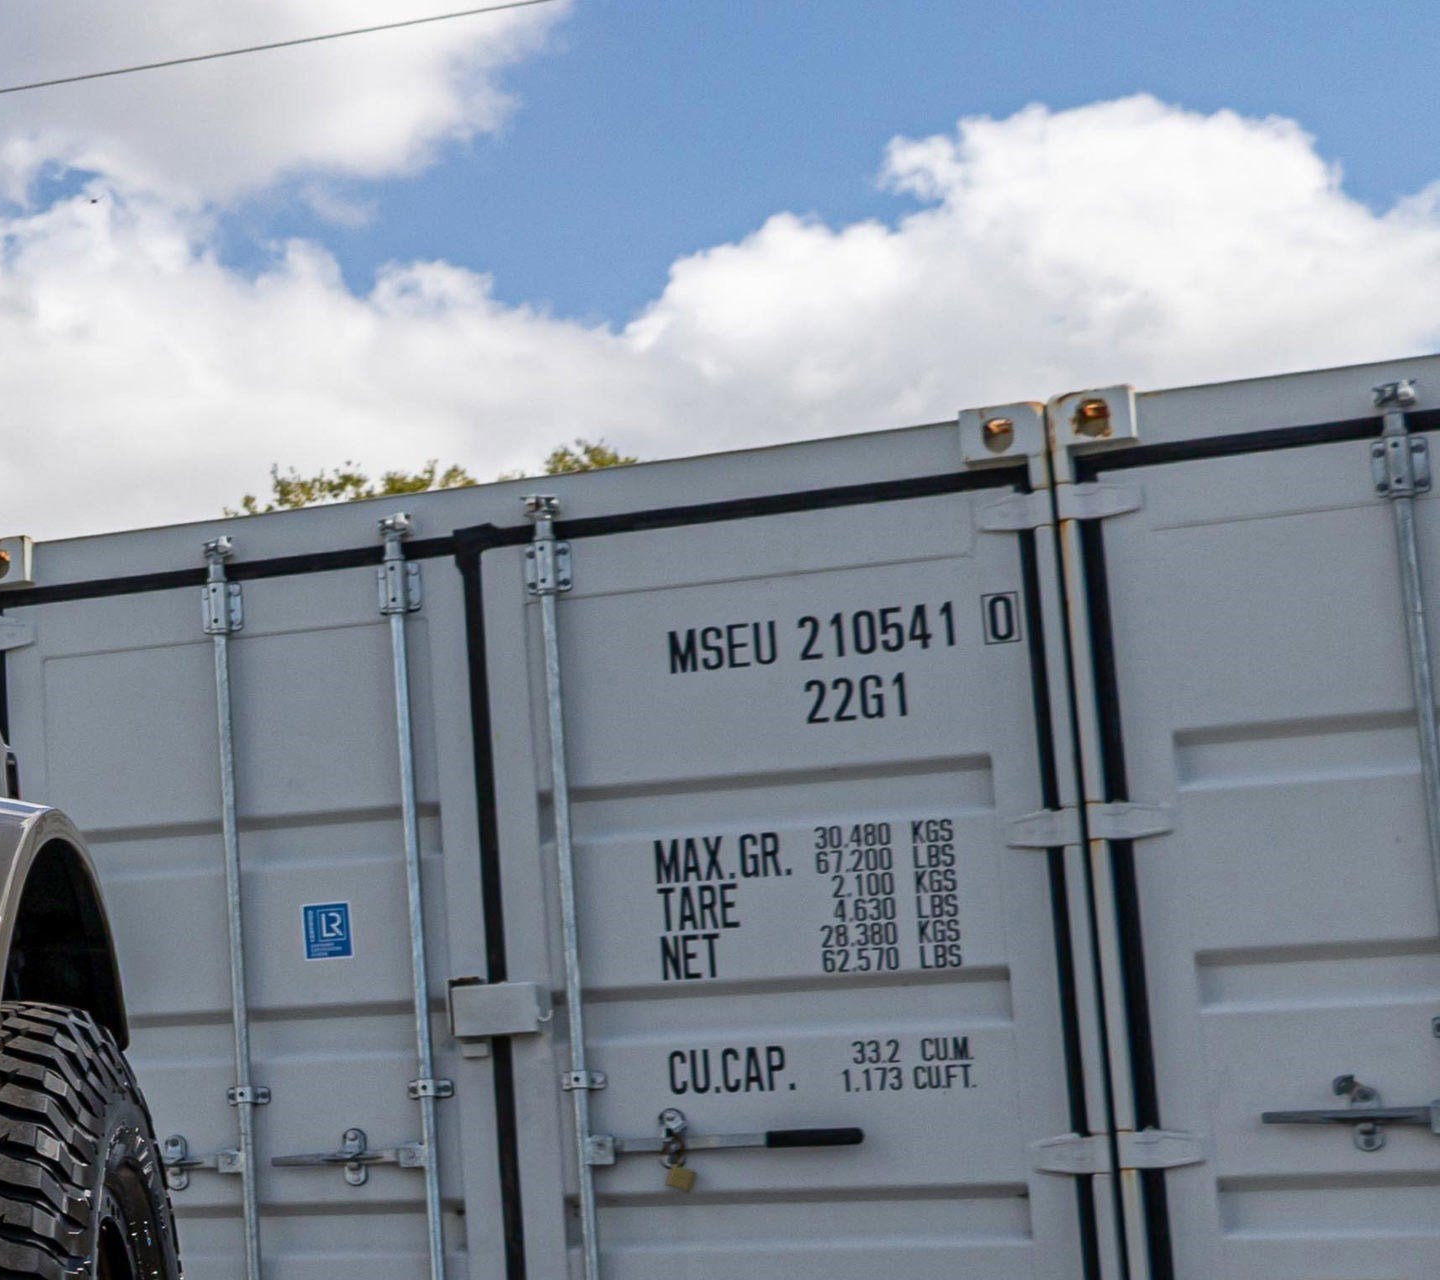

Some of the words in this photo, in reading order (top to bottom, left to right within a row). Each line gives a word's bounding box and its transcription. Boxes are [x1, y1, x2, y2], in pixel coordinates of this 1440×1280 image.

[668, 620, 778, 674] MSEU
[797, 601, 956, 661] 210541
[804, 672, 908, 724] 22G1
[654, 832, 792, 884] MAX.GR.
[814, 822, 891, 850] 30.480
[911, 819, 954, 844] KGS
[815, 847, 893, 874] 67.200
[913, 844, 955, 869] LBS
[656, 883, 741, 932] TARE
[832, 872, 895, 898] 2.100
[915, 869, 957, 894] KGS
[834, 897, 896, 922] 4.630
[916, 894, 959, 919] LBS
[660, 933, 720, 981] NET
[820, 922, 898, 948] 28.380
[918, 919, 961, 944] KGS
[822, 947, 899, 973] 62.570
[919, 944, 962, 969] LBS
[668, 1045, 796, 1095] CU.CAP.
[852, 1039, 901, 1065] 33.2
[842, 1067, 903, 1092] 1.173
